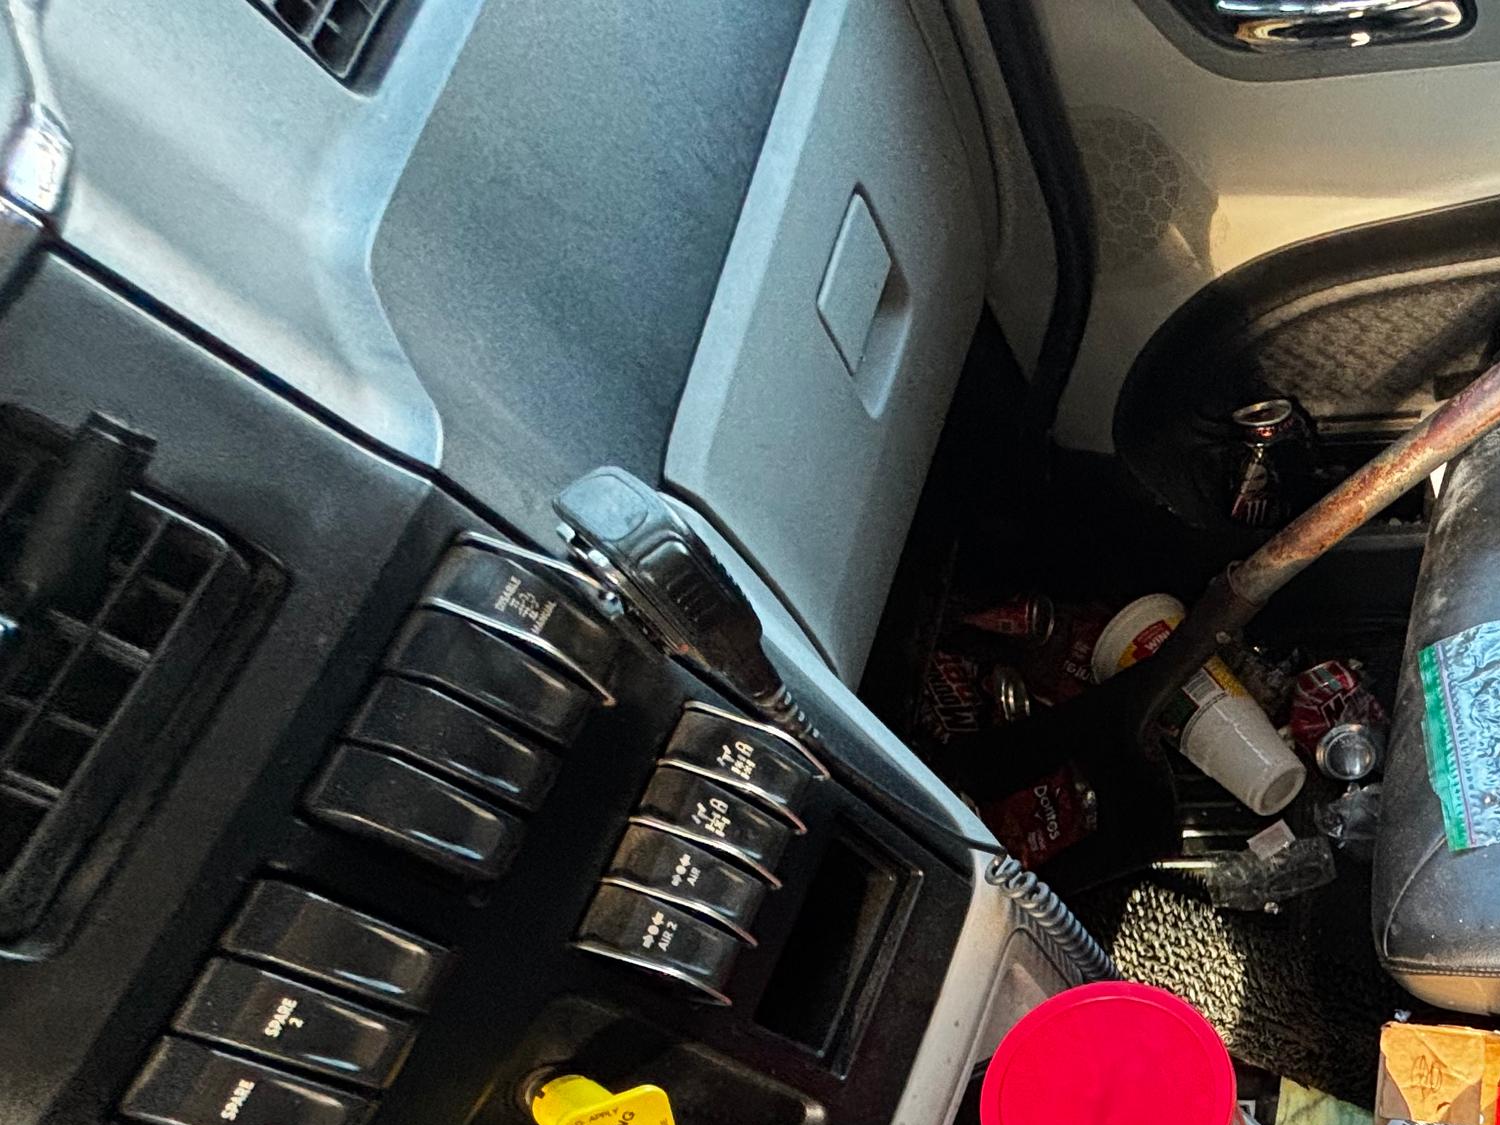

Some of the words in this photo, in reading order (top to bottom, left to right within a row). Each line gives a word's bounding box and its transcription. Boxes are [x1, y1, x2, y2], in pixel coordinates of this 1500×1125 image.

[1033, 784, 1060, 840] Doritos
[686, 865, 702, 887] AIR
[657, 929, 674, 952] AIR
[667, 920, 678, 931] 2
[264, 997, 298, 1038] SPARE
[288, 1016, 305, 1028] 2
[220, 1079, 255, 1120] SPARE
